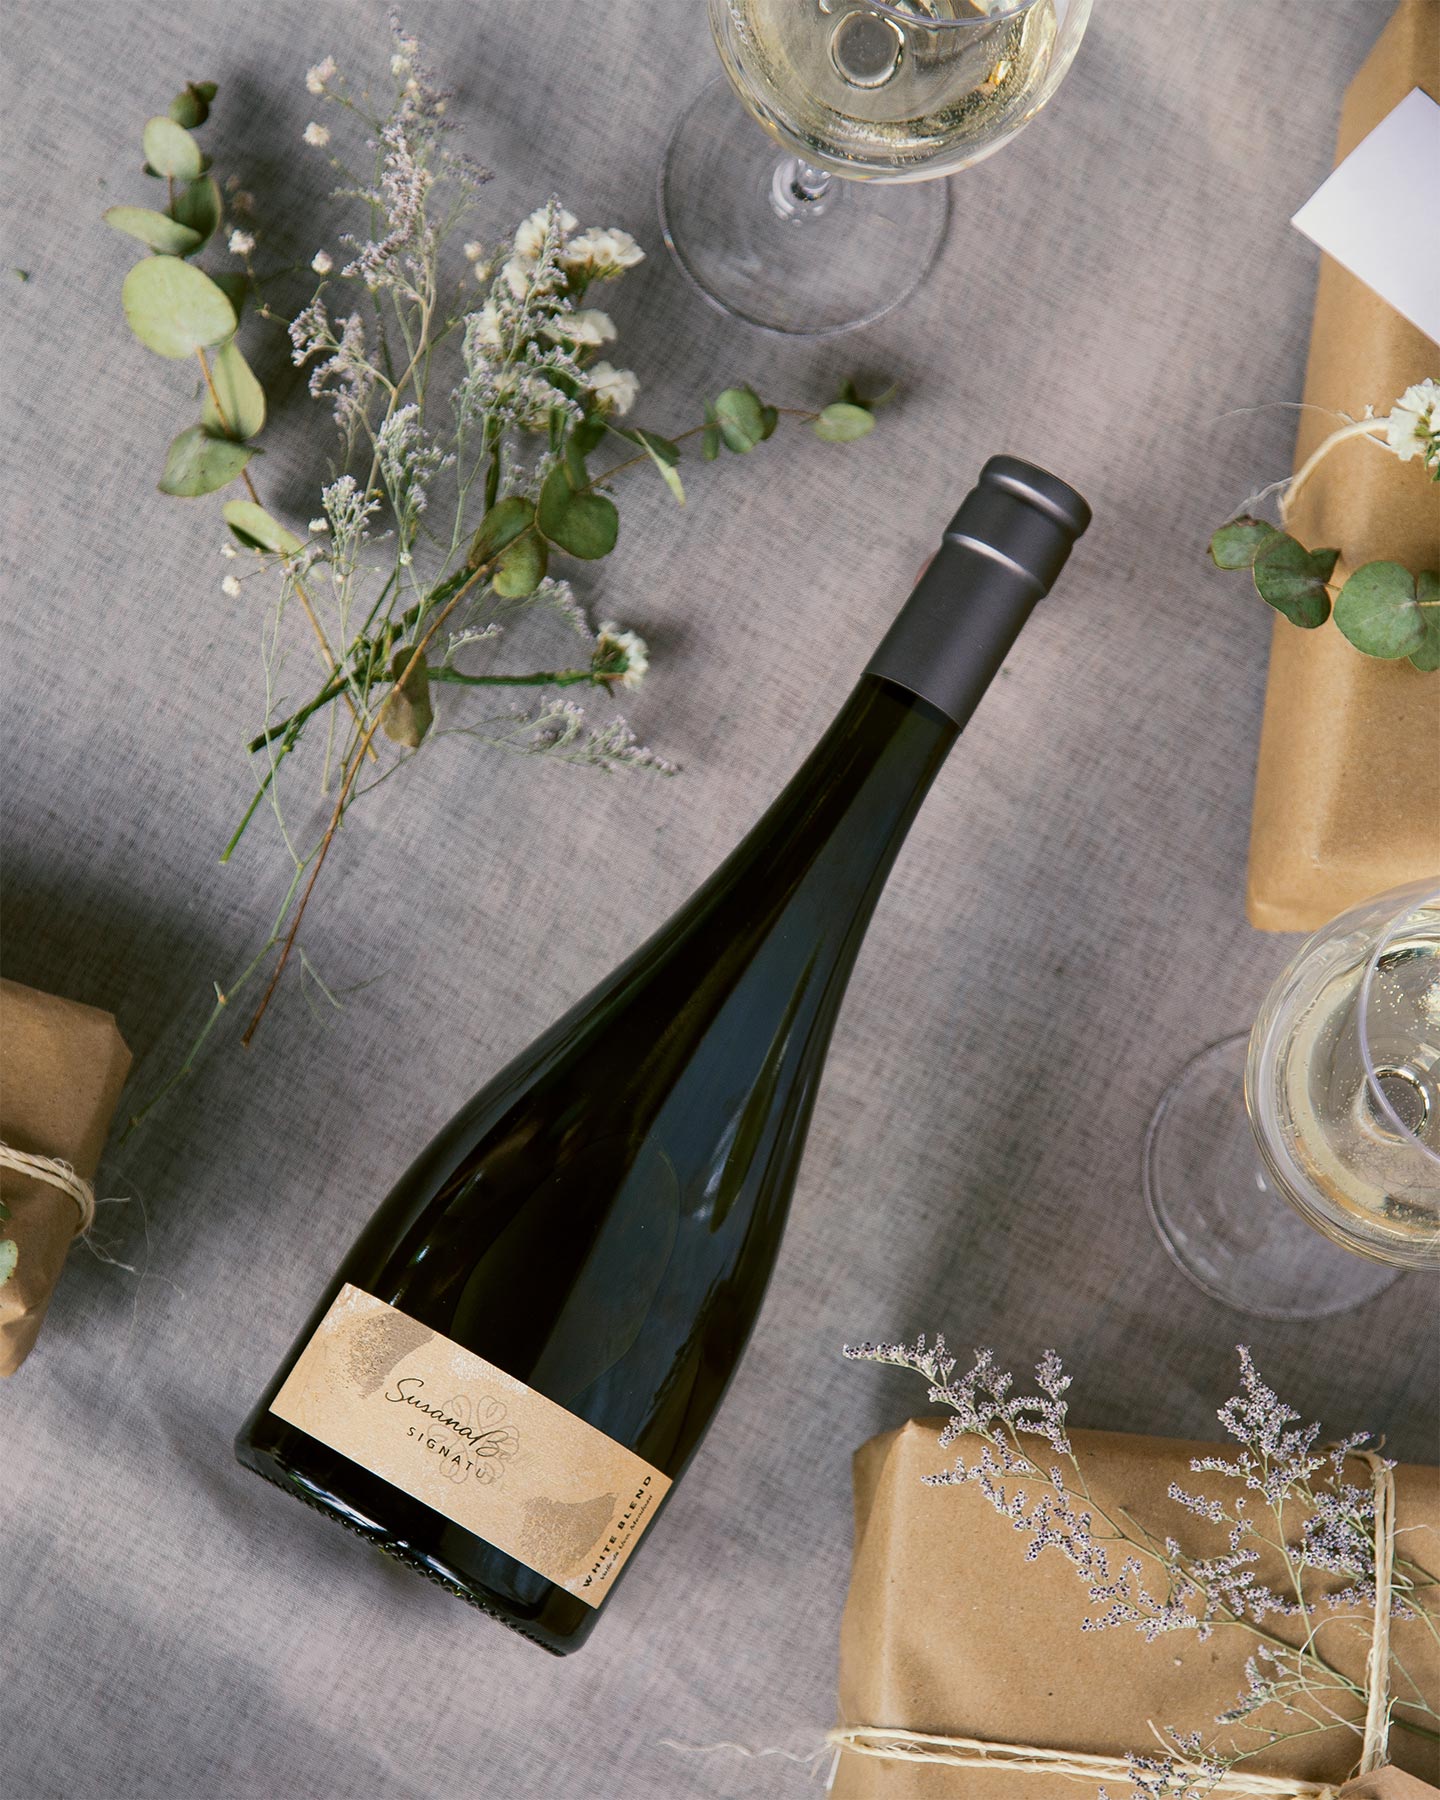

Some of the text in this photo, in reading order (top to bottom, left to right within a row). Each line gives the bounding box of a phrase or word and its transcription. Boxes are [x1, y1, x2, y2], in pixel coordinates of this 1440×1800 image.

[384, 1377, 476, 1441] Susana
[406, 1426, 503, 1490] SIGNATU
[582, 1475, 652, 1588] WHITE BLEND
